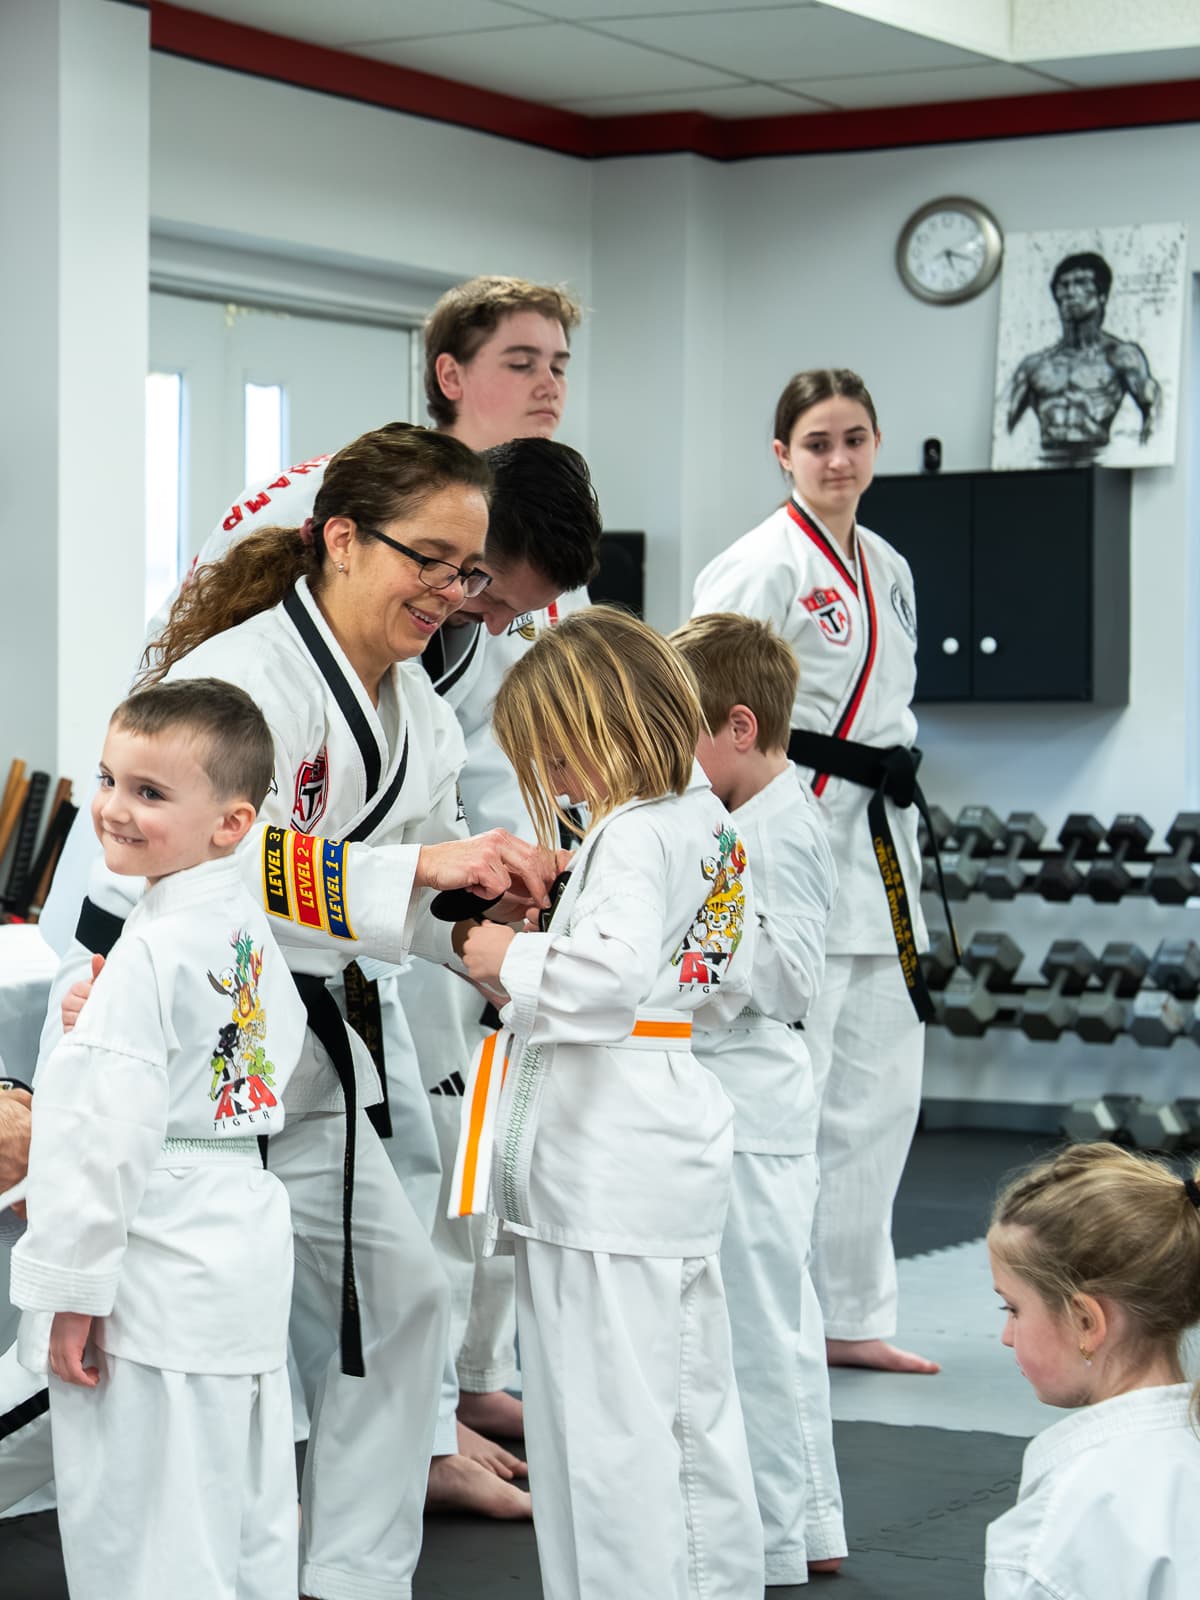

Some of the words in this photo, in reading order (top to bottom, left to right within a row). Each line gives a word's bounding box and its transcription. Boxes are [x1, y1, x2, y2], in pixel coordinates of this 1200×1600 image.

[223, 454, 330, 531] HAMP
[516, 612, 534, 627] LEG
[268, 848, 284, 896] LEVEL
[297, 861, 315, 909] LEVEL
[327, 875, 344, 923] LEVEL
[679, 985, 710, 993] TIG
[214, 1110, 271, 1131] TIGER
[215, 1074, 278, 1121] ATA
